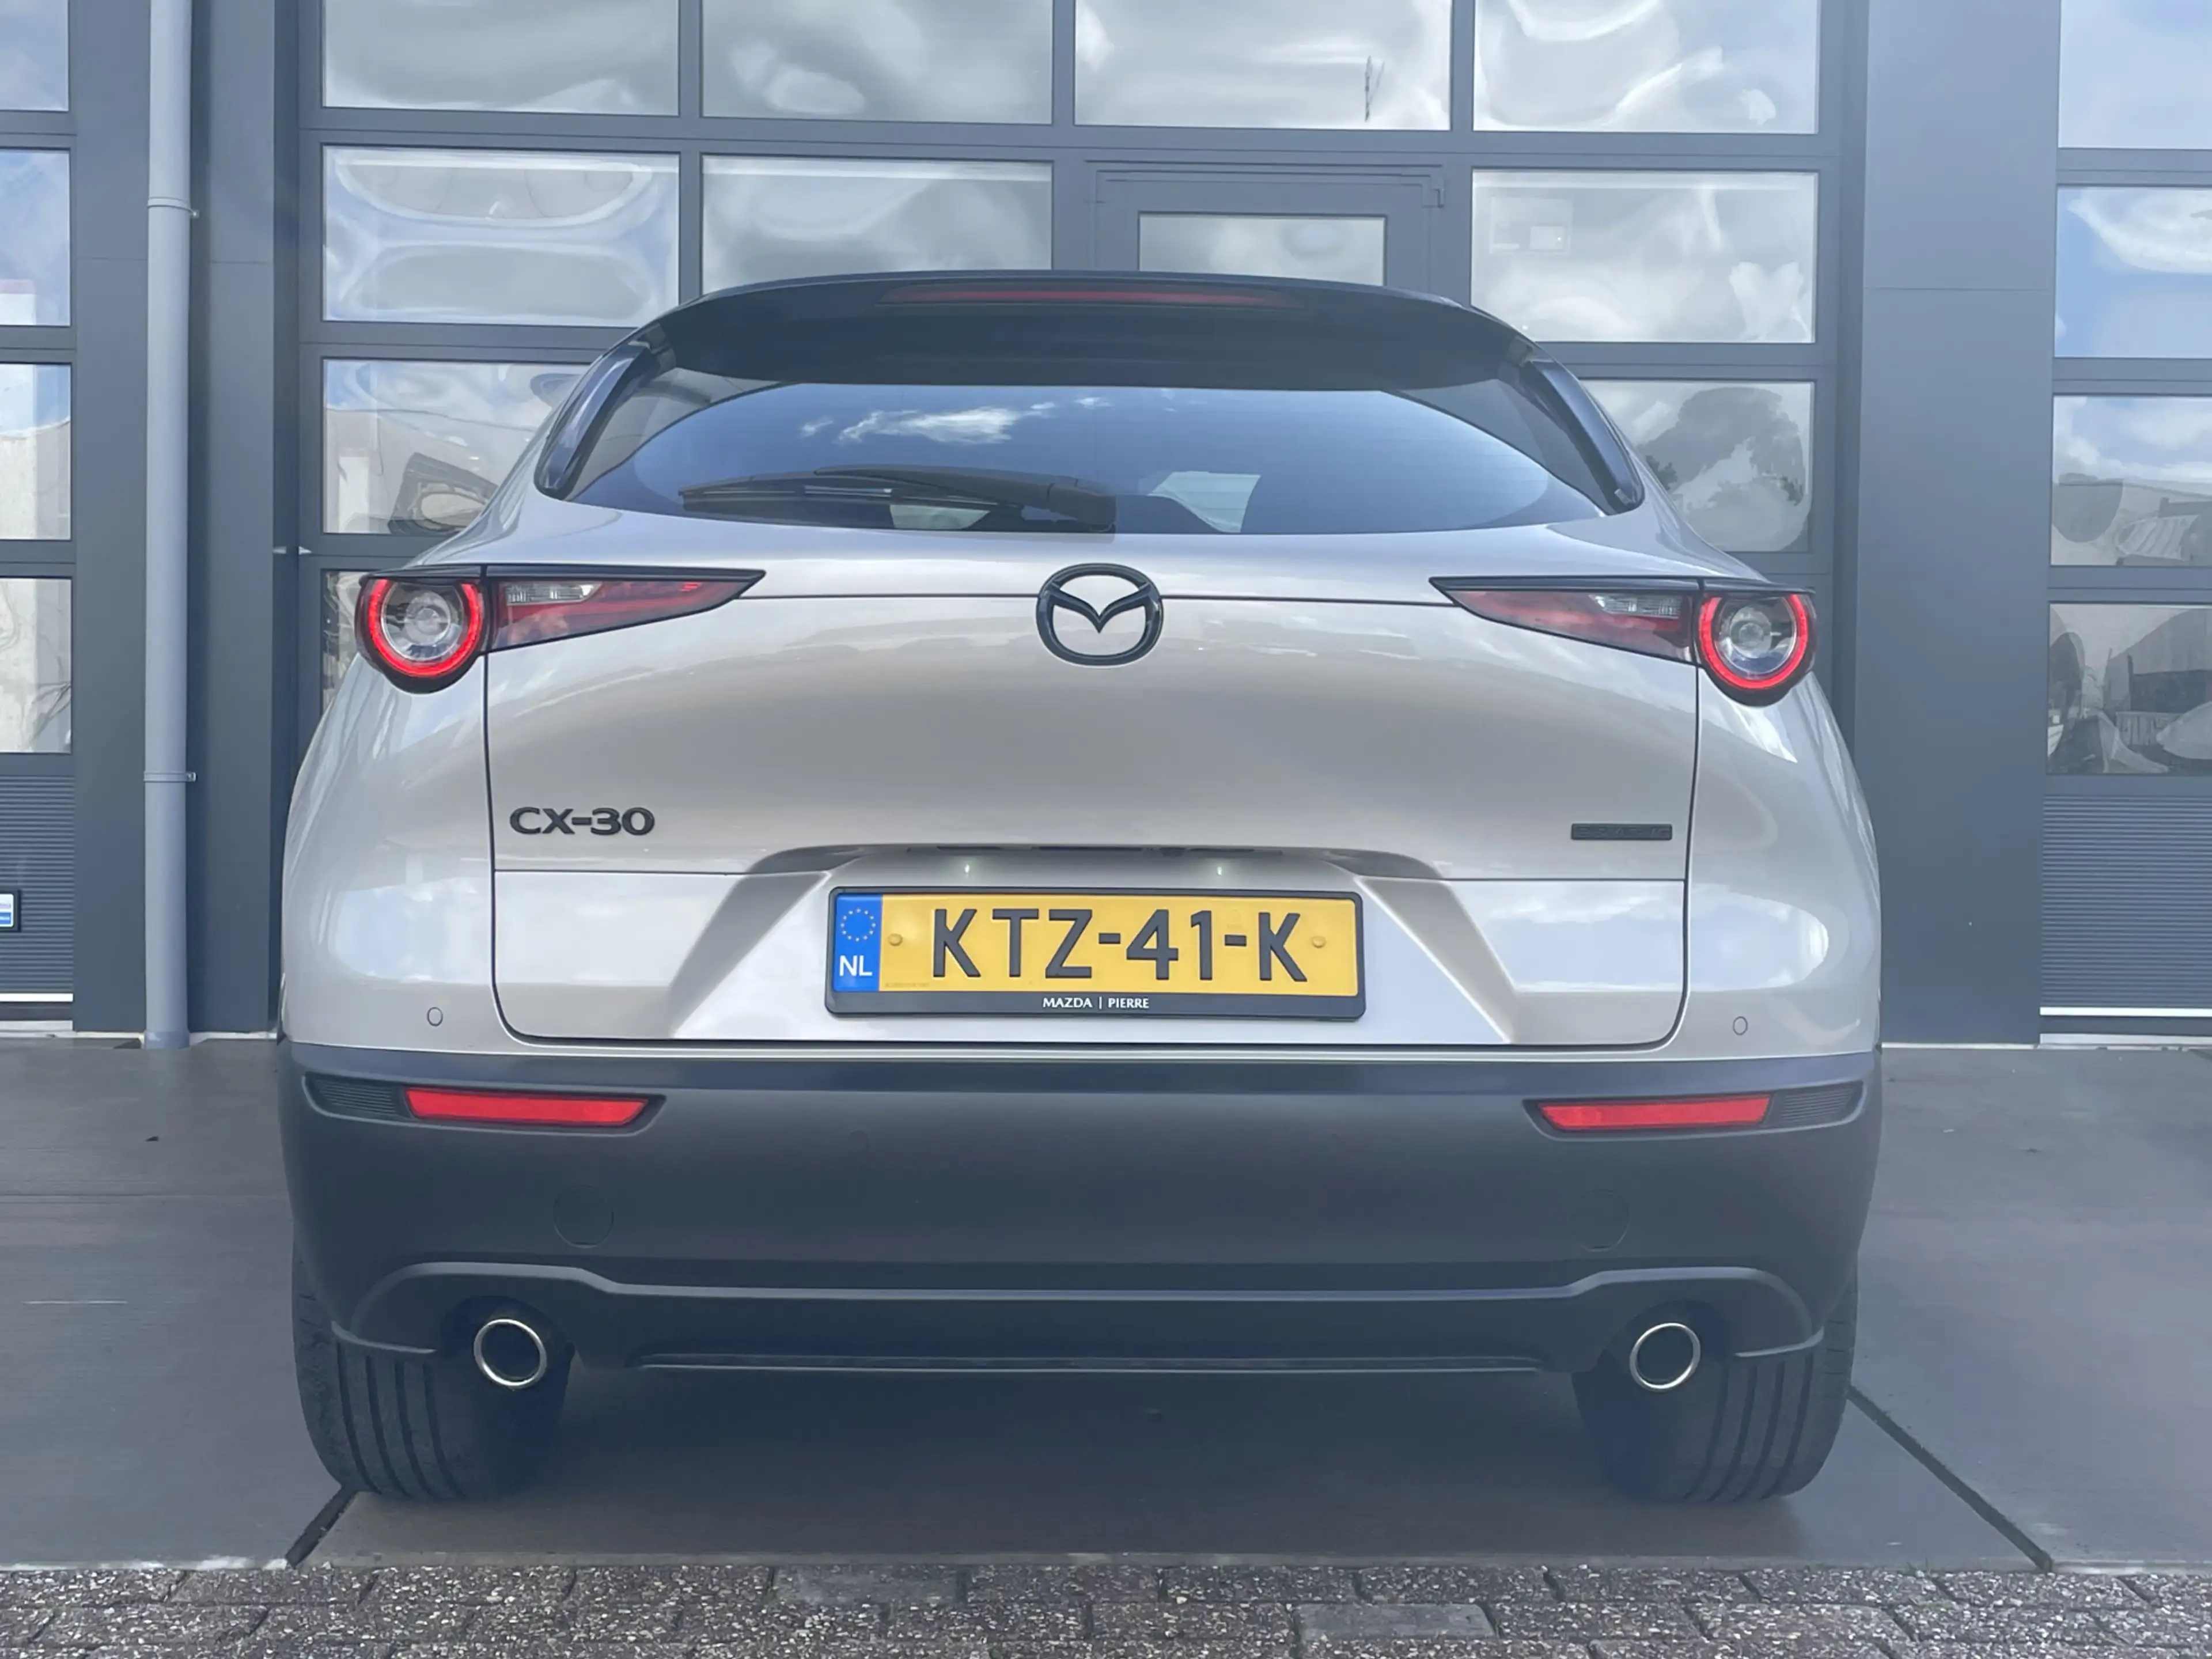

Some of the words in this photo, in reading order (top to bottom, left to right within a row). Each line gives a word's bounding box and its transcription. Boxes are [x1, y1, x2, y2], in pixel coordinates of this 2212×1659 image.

[509, 806, 656, 836] CX-30
[931, 908, 1308, 982] KTZ-41-K
[839, 956, 873, 977] NL
[1042, 997, 1093, 1009] MAZDA
[1107, 998, 1150, 1009] PIERRE
